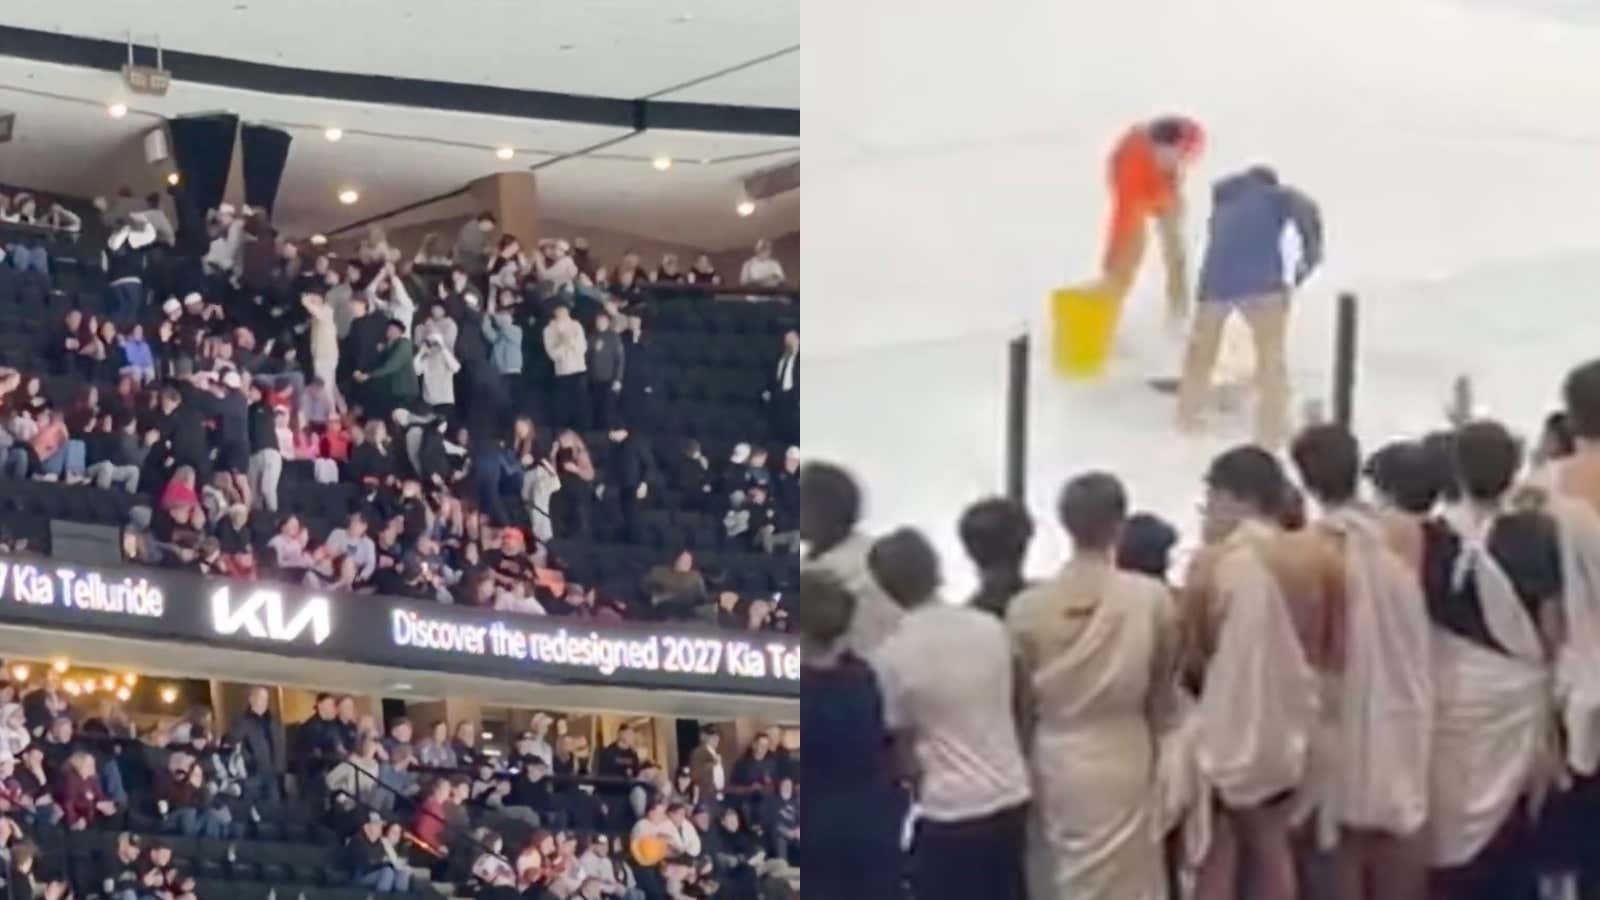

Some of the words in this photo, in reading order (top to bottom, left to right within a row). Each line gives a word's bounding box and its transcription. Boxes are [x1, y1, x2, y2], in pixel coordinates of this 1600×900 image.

[12, 564, 54, 604] Kia
[55, 569, 164, 618] Telluride
[210, 586, 331, 645] KIA
[392, 608, 487, 655] Discover
[490, 622, 528, 657] the
[529, 629, 660, 674] redesigned
[663, 635, 721, 673] 2027
[726, 640, 765, 677] Kia
